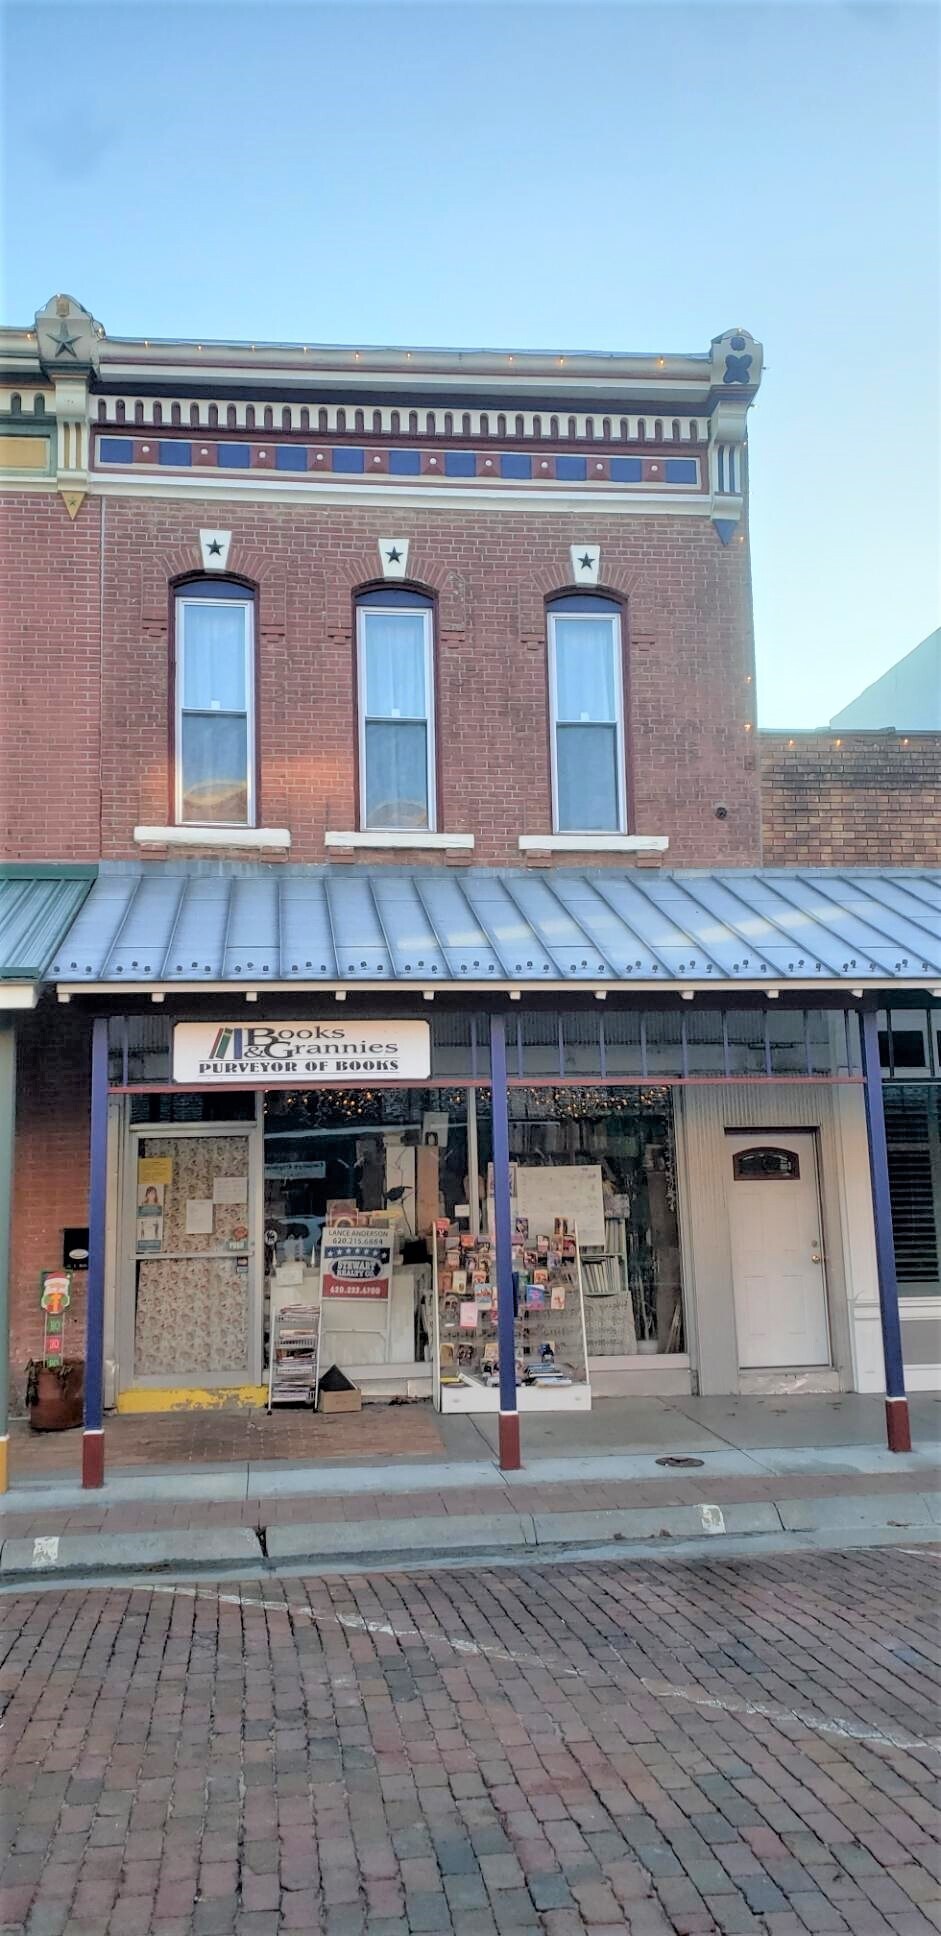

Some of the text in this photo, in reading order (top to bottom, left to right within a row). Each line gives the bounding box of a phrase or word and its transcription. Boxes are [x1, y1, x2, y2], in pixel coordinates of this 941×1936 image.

[244, 1026, 345, 1046] Books
[199, 1059, 400, 1074] PURVEYOR OF BOOKS
[337, 1260, 375, 1270] STEWART
[336, 1269, 364, 1277] REALTY
